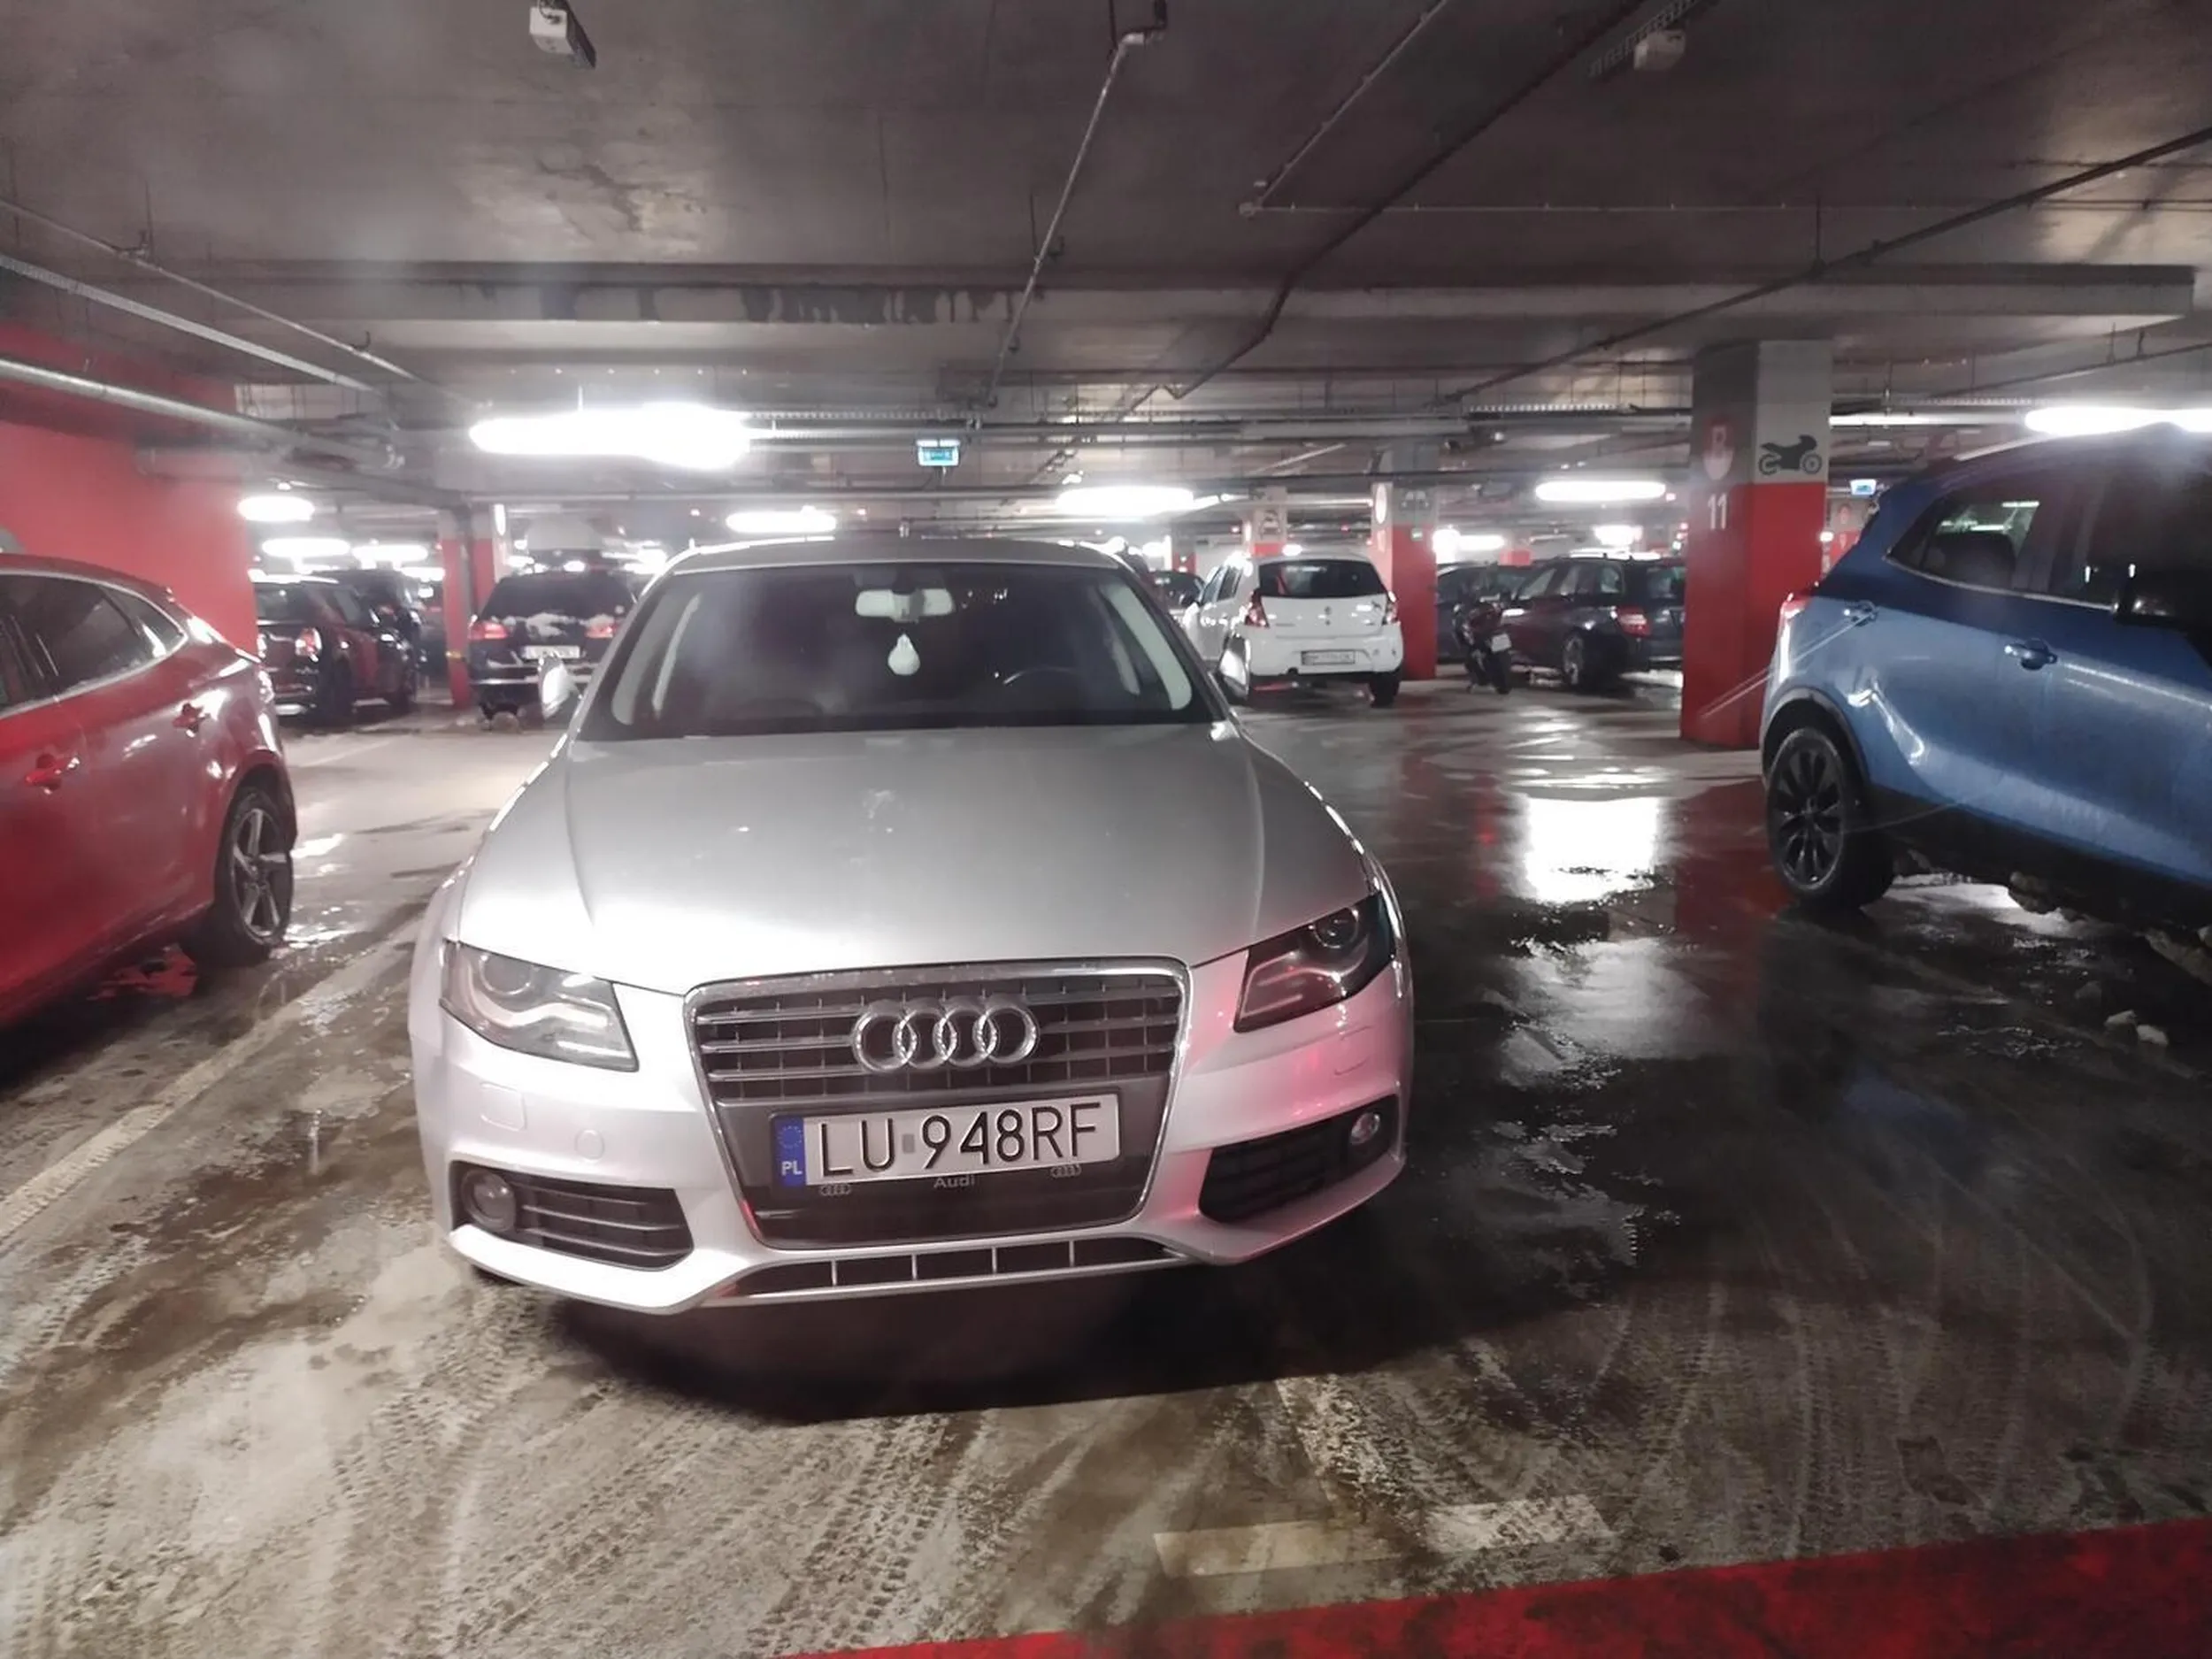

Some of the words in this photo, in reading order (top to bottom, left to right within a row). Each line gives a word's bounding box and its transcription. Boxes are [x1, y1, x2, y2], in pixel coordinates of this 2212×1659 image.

[1708, 493, 1727, 530] 11
[819, 1118, 894, 1178] LU
[922, 1102, 1102, 1170] 948RF
[781, 1160, 803, 1176] PL
[933, 1174, 975, 1188] Audi
